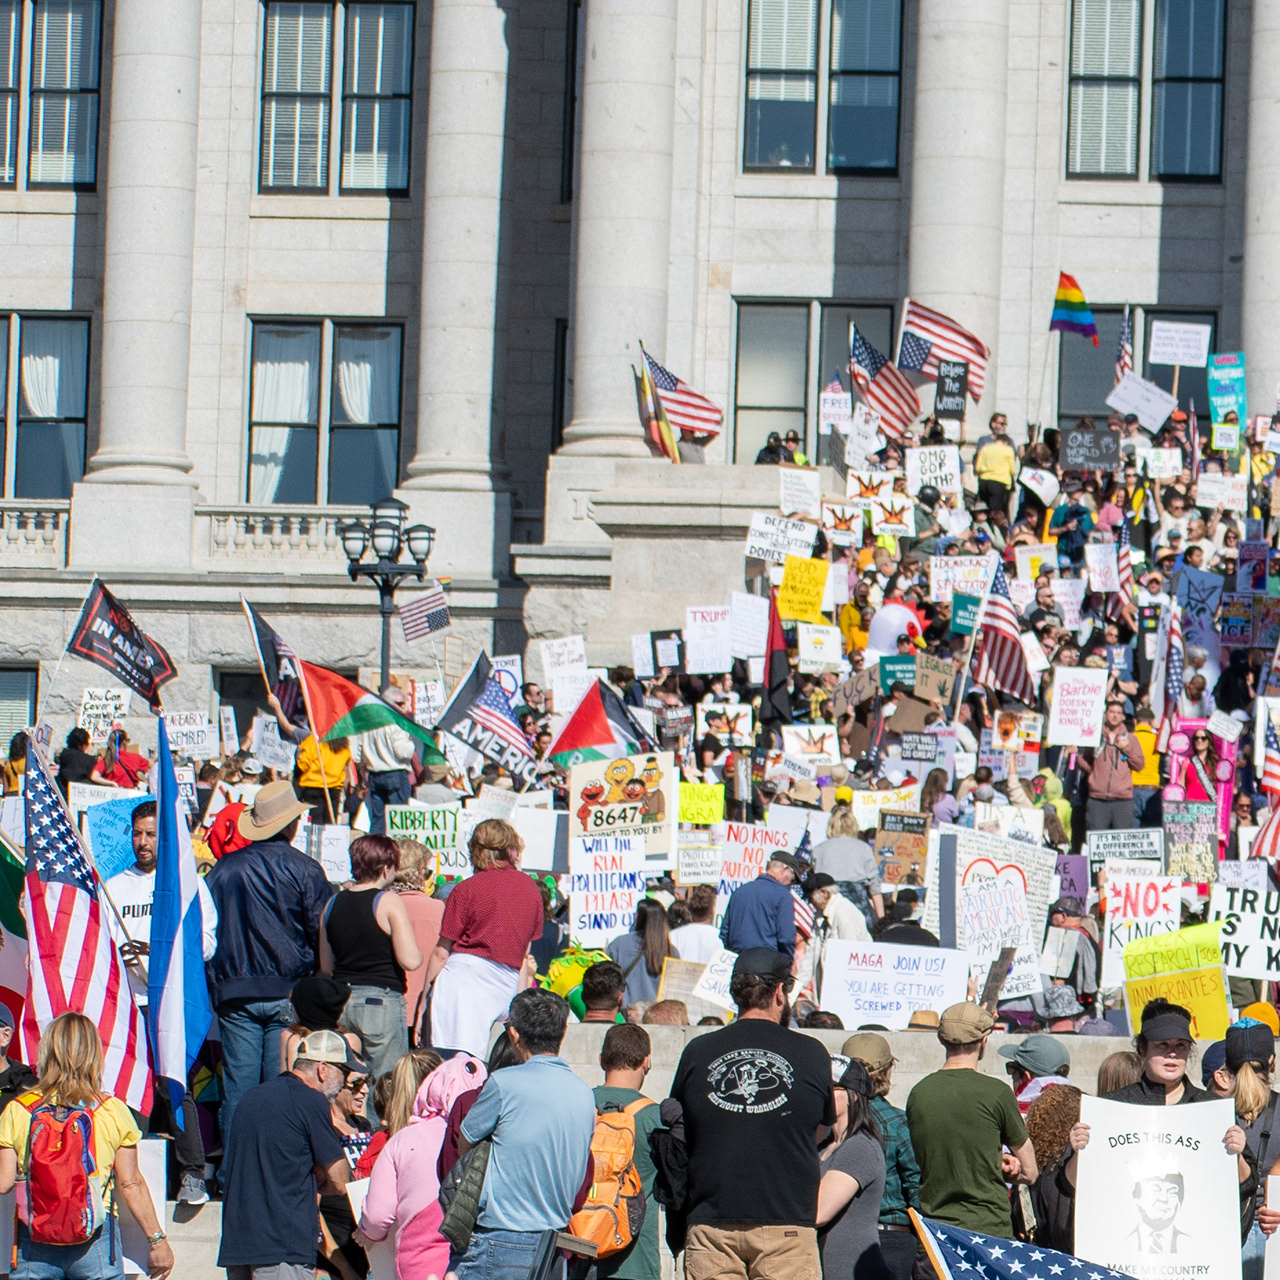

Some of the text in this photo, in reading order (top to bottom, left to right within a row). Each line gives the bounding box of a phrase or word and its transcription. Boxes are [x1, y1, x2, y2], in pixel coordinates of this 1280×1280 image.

[1068, 432, 1095, 447] ONE
[919, 449, 947, 464] OMG
[921, 462, 946, 476] GOP
[765, 516, 806, 533] DEFEND
[790, 560, 817, 576] GOD
[692, 610, 730, 623] TRUMP
[92, 618, 114, 638] IN
[1061, 683, 1101, 699] Barbie
[1060, 709, 1079, 718] BOW
[1060, 718, 1084, 727] KINGS
[913, 751, 936, 760] GREAT
[389, 807, 460, 833] RIBBERTY
[593, 804, 642, 828] 8647
[424, 833, 458, 850] ALL!
[727, 824, 790, 848] NO KINGS
[1123, 833, 1151, 842] LONGER
[1093, 849, 1158, 860] POLITICAL OPINION
[1104, 841, 1144, 851] DIFFERENCE
[743, 848, 765, 868] NO
[567, 870, 646, 894] POLITICIANS
[585, 890, 636, 911] PLEASE
[1123, 882, 1160, 918] NO
[578, 910, 618, 932] STAND
[1214, 911, 1242, 938] IS
[848, 952, 947, 972] MAGA JOIN US!
[1128, 944, 1192, 979] RESEARCH
[844, 980, 946, 998] YOU ARE GETTING
[853, 998, 903, 1012] SCREWED
[1108, 1133, 1202, 1152] DOES THIS ASS
[1161, 1264, 1211, 1277] COUNTRY
